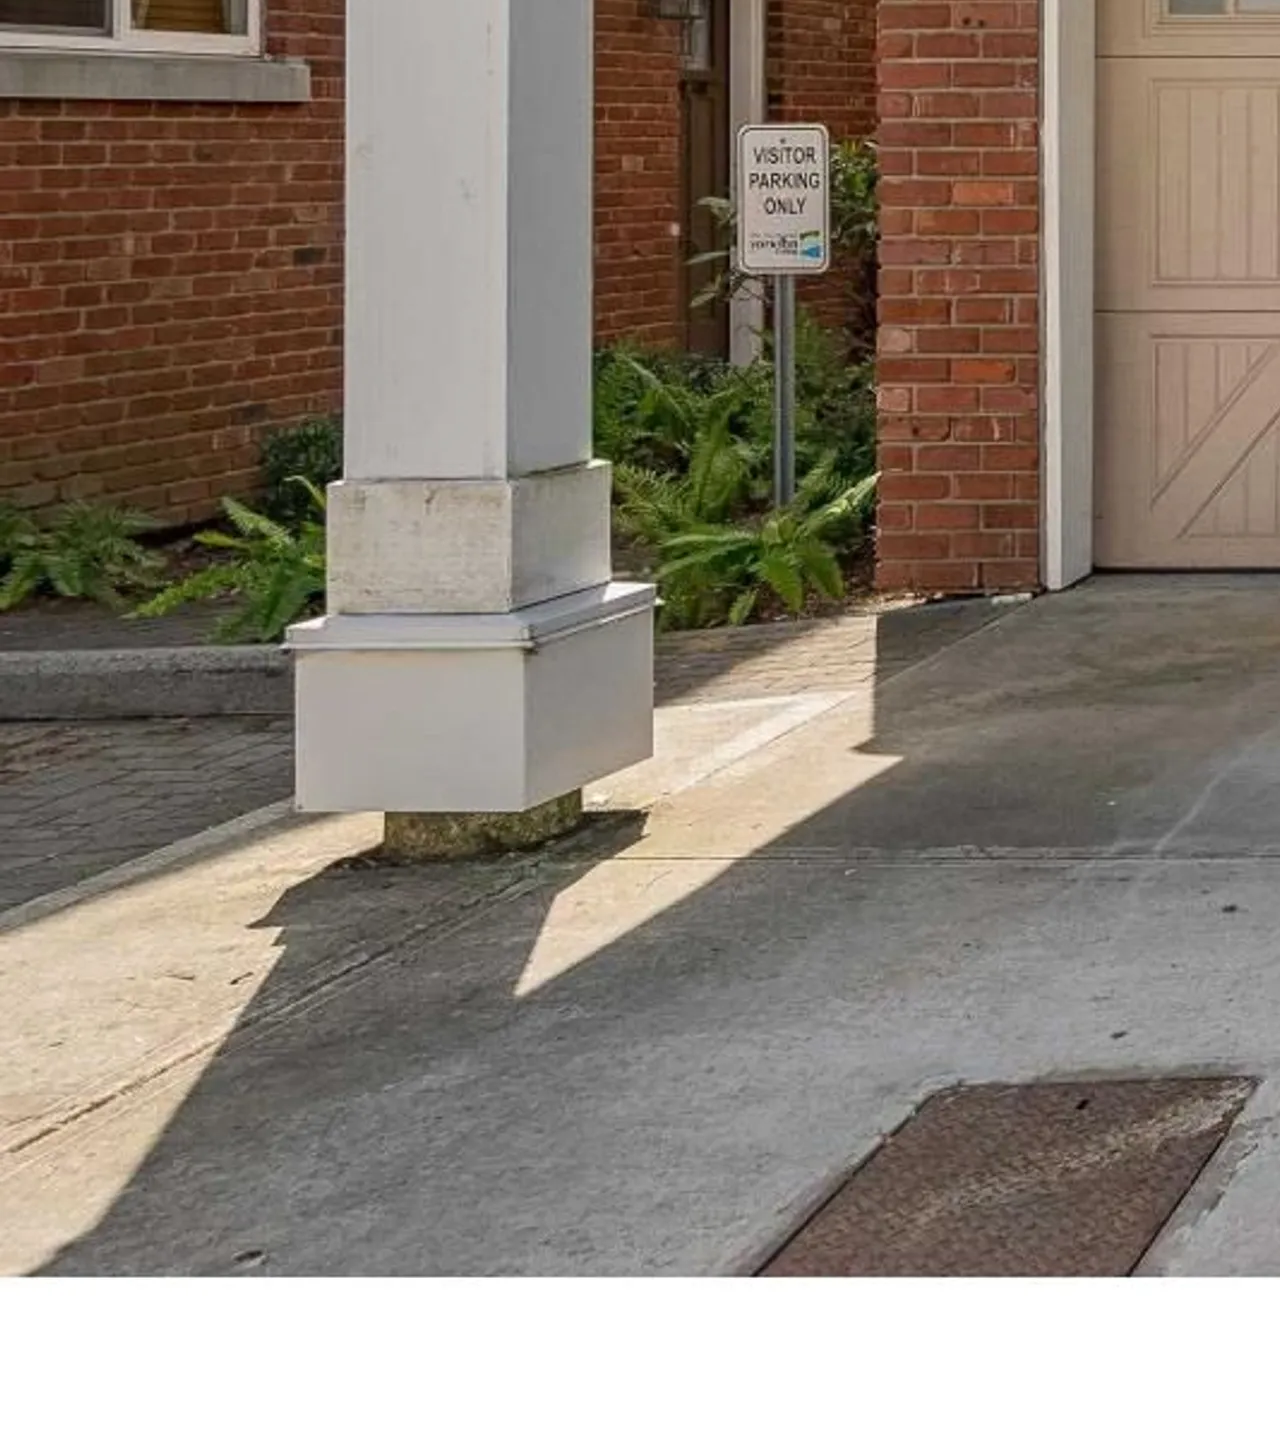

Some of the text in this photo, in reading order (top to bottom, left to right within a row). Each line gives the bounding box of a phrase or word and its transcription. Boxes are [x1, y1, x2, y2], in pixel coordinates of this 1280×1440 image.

[753, 147, 816, 164] VISITOR
[749, 172, 820, 190] PARKING
[763, 197, 807, 215] ONLY
